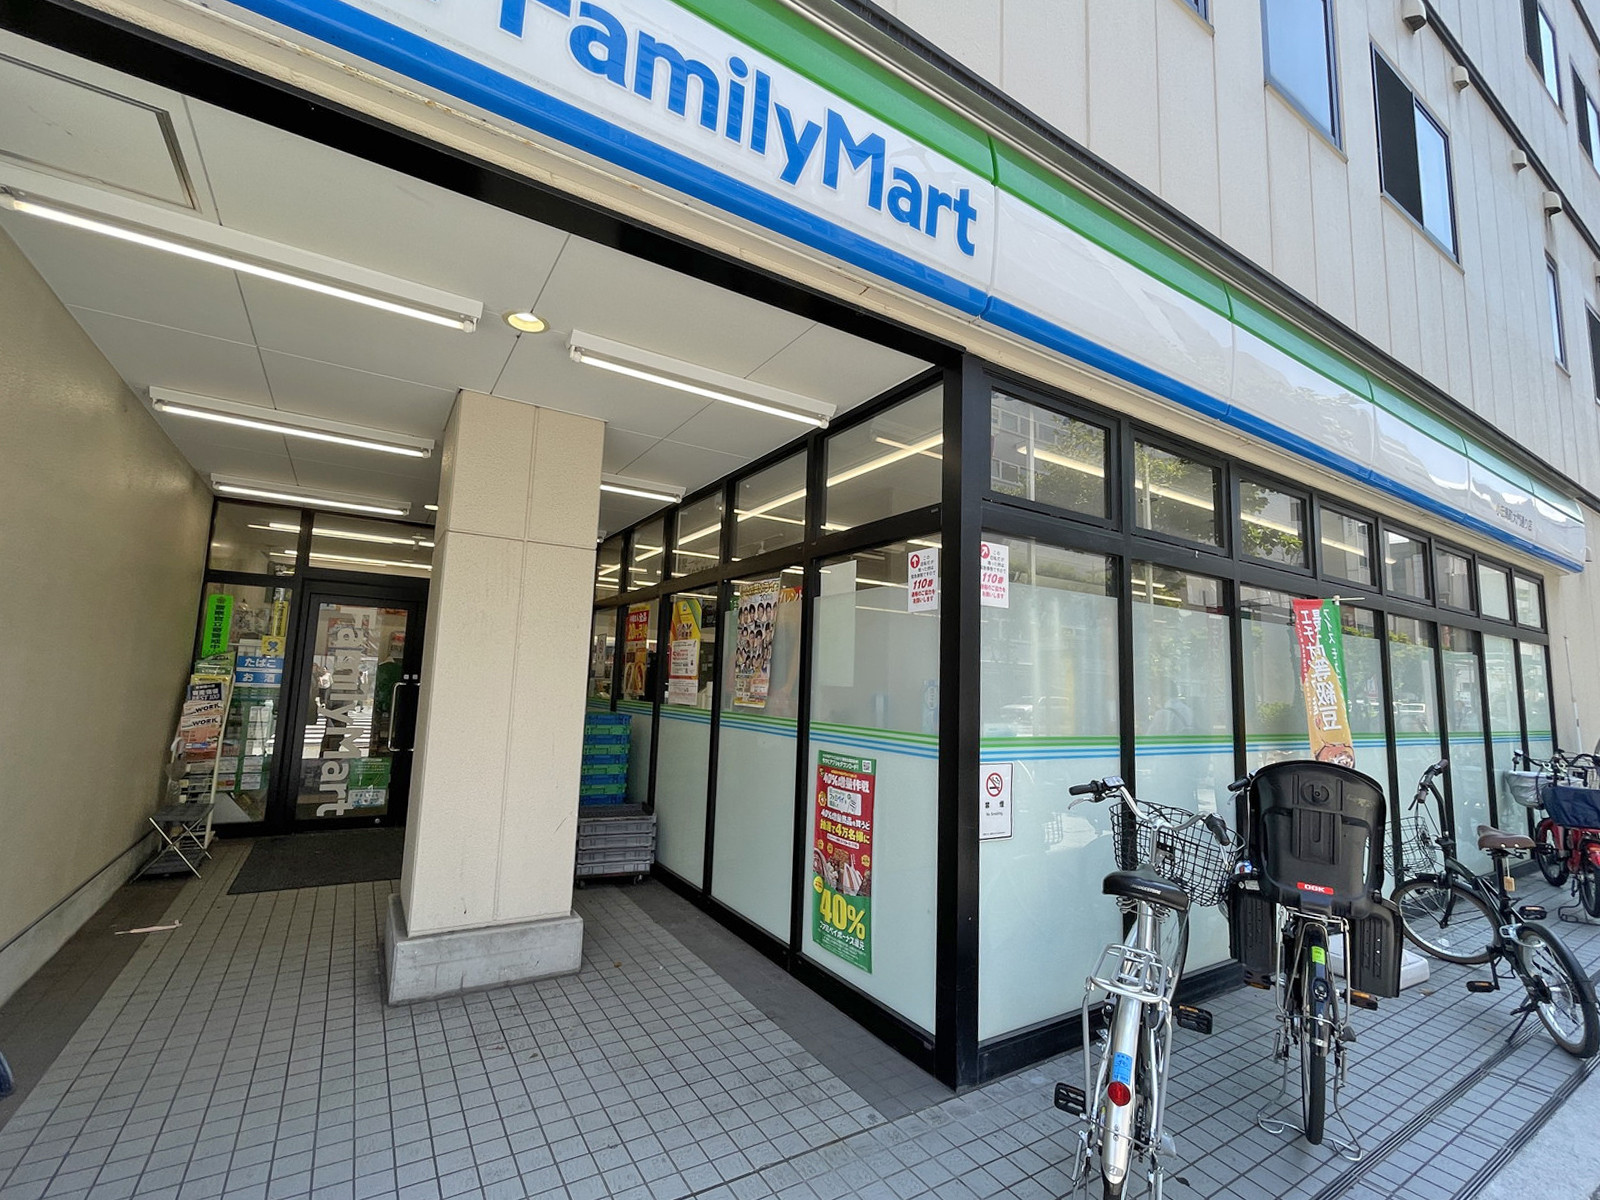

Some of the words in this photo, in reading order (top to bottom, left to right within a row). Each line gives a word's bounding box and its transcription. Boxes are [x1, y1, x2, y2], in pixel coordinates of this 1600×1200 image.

[913, 578, 934, 590] 110番
[982, 572, 1004, 584] 110番
[244, 657, 277, 668] たばこ
[242, 672, 276, 684] お酒
[195, 702, 221, 713] WORK
[192, 717, 218, 727] WORK
[820, 888, 865, 940] 40%
